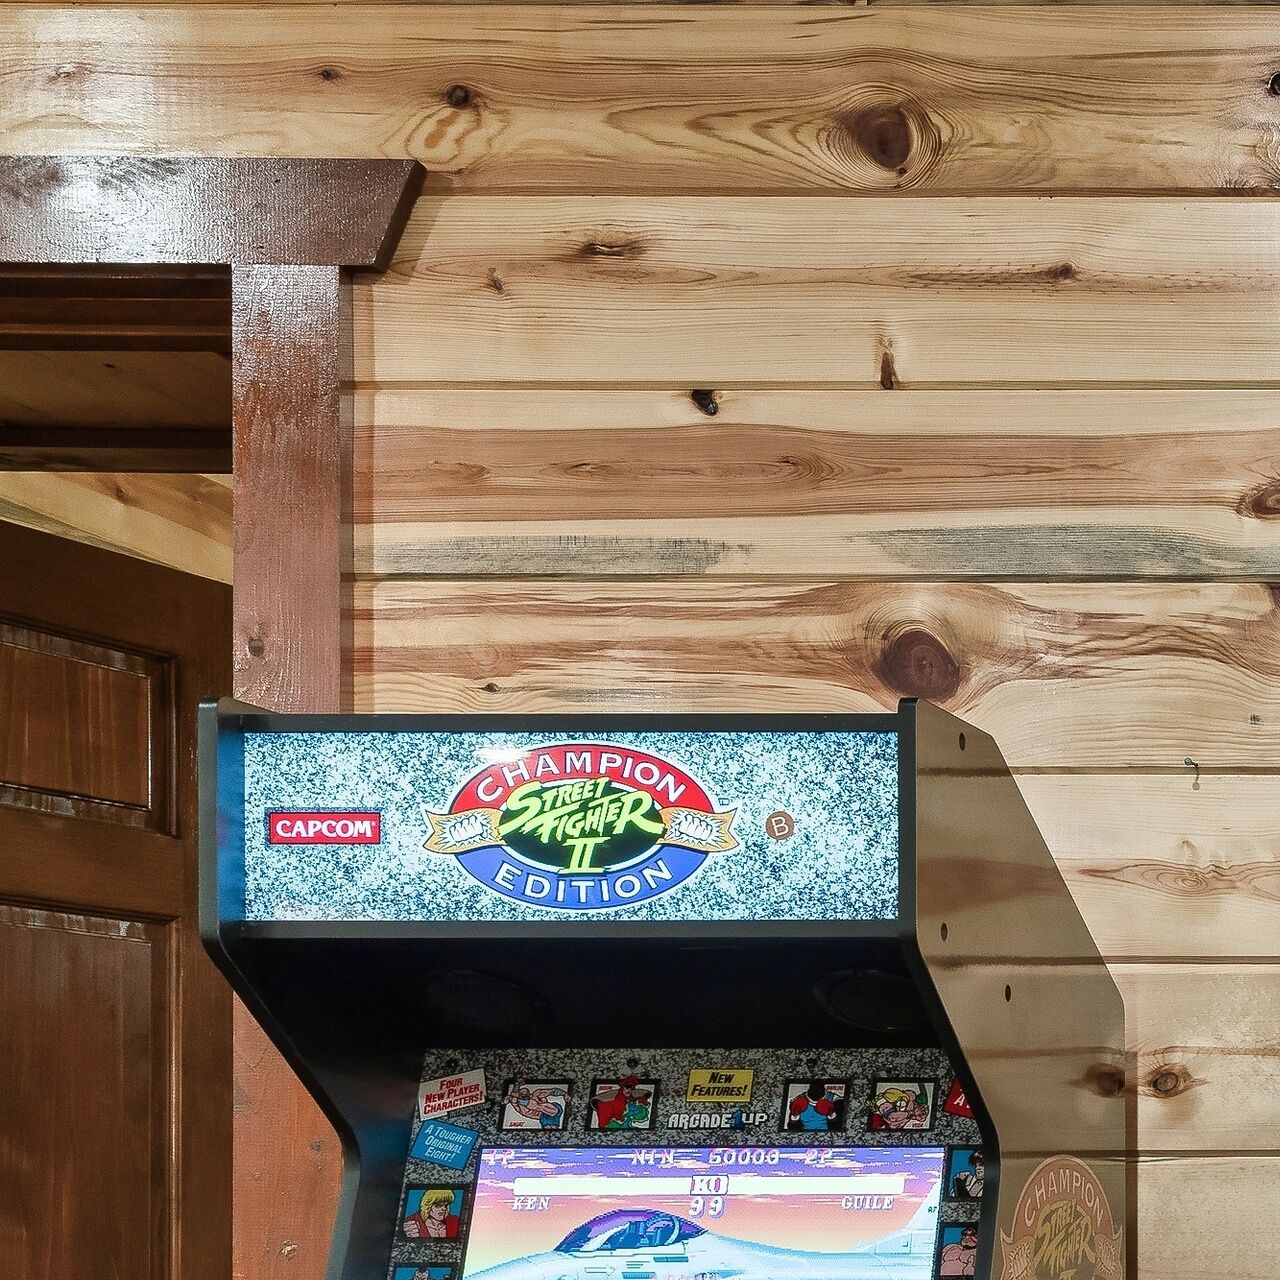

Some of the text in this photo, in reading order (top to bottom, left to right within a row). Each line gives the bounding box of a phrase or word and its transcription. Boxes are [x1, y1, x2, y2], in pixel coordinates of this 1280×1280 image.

[476, 751, 686, 803] CHAMPION
[499, 777, 612, 835] STREET
[525, 790, 668, 844] FIGHTER
[772, 816, 790, 836] B
[558, 837, 612, 875] II
[494, 859, 674, 903] EDITION
[440, 1077, 463, 1090] FOUR
[708, 1070, 735, 1084] NEW
[425, 1083, 480, 1104] NEW PLAYER
[691, 1084, 749, 1097] FEATURES!
[423, 1090, 484, 1115] CHARACTERS!
[667, 1108, 769, 1131] ARCADE1UP
[425, 1124, 473, 1145] A TOUGHER
[425, 1135, 463, 1154] ORIGINAL
[425, 1146, 456, 1163] EIGHT!
[708, 1149, 780, 1166] 50000
[512, 1196, 551, 1213] KEN
[689, 1196, 726, 1218] 99
[841, 1195, 895, 1211] GUILE
[1024, 1168, 1104, 1229] CHAMPION
